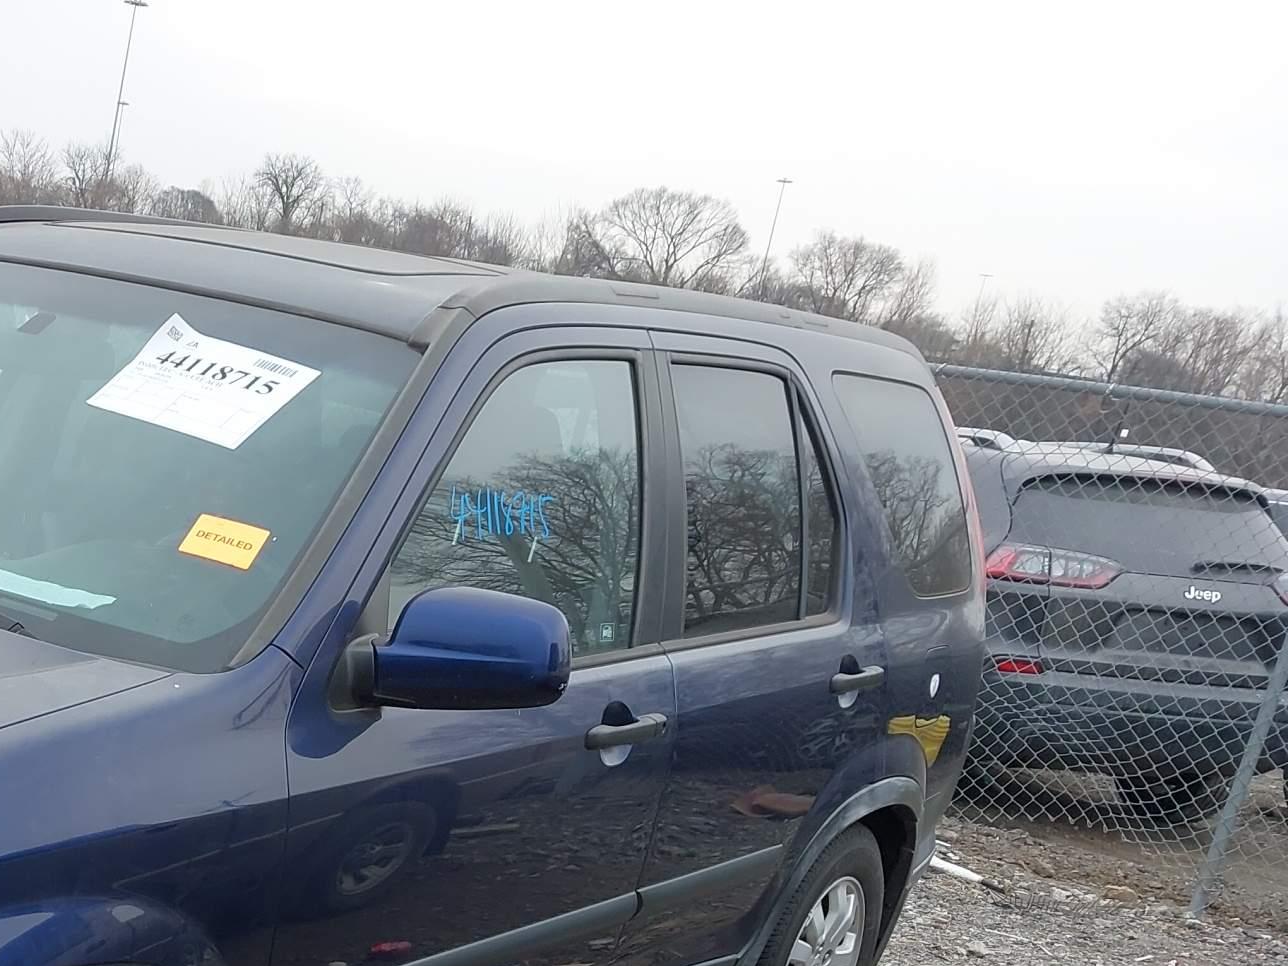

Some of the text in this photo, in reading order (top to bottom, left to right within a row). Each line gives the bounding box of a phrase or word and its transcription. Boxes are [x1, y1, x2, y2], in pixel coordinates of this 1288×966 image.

[156, 350, 280, 395] 44118715
[195, 530, 253, 551] DETAILED
[1184, 586, 1221, 603] Jeep
